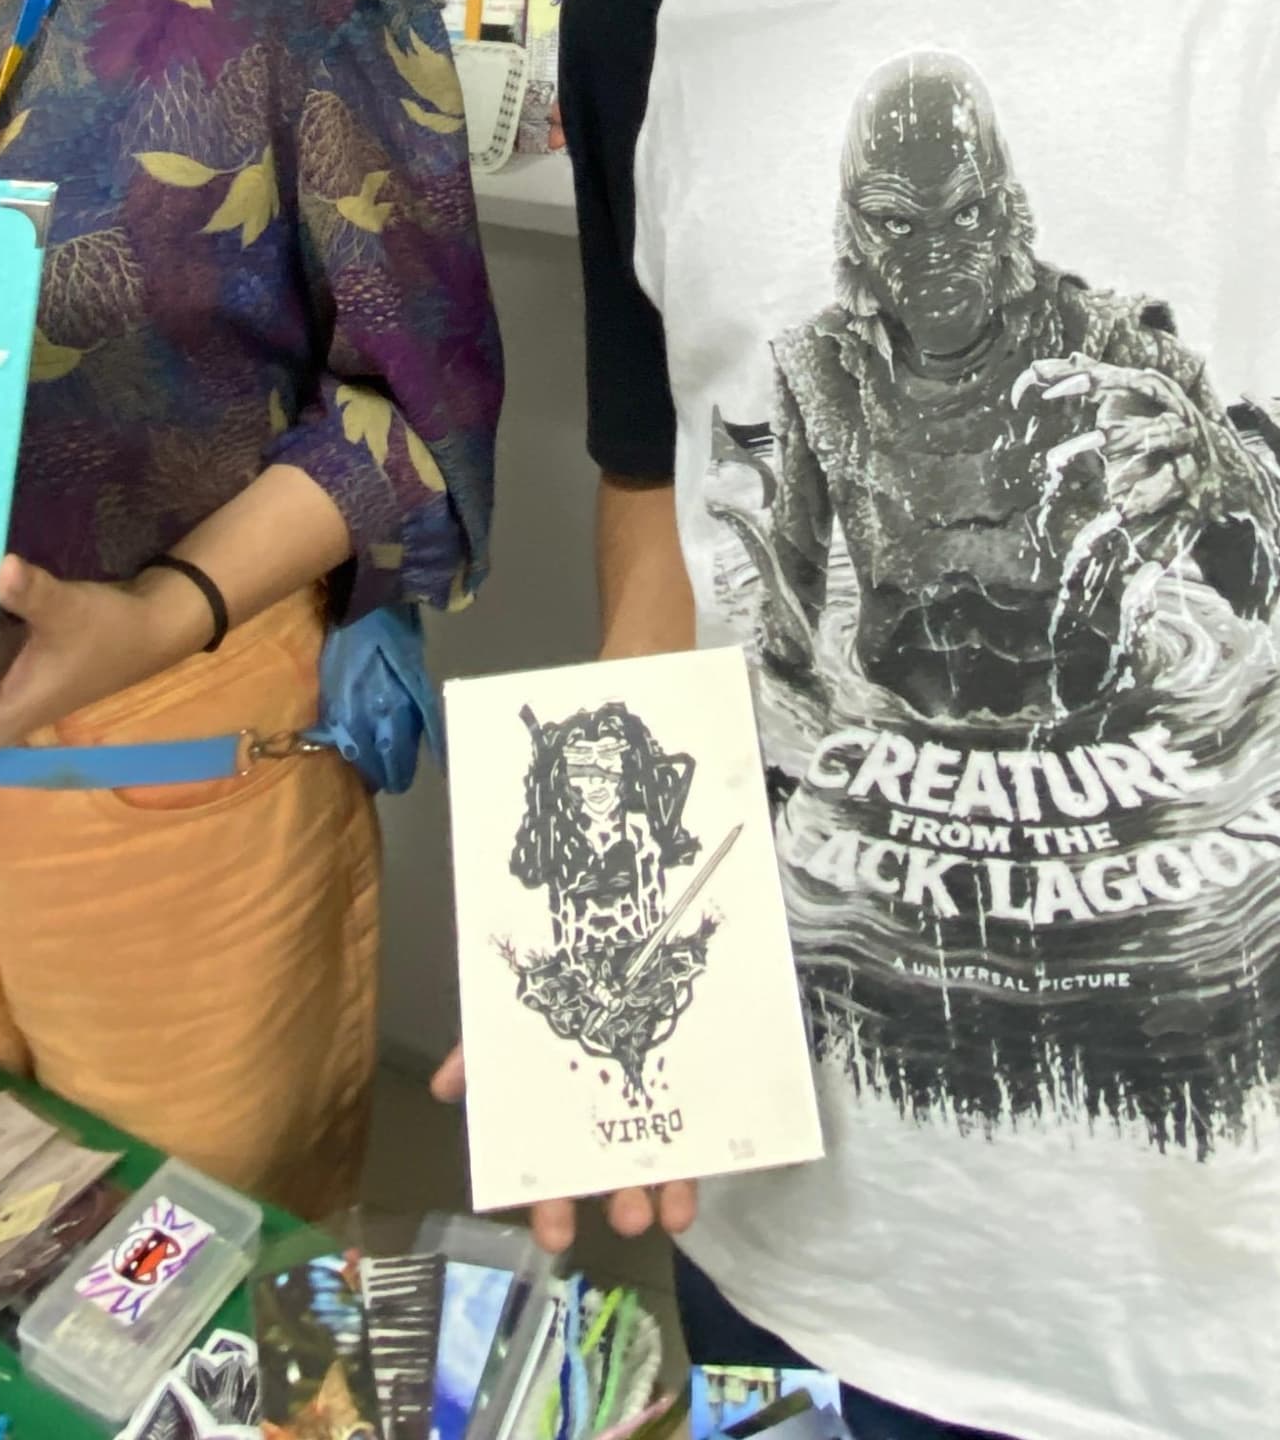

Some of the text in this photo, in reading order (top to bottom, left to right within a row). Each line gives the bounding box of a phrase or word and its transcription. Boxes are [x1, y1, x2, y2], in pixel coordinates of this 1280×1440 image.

[806, 724, 1220, 823] CREATURE
[888, 809, 1119, 855] FROM THE
[893, 957, 1131, 993] A UNIVERSAL PICTURE
[596, 1108, 684, 1144] VIRGO
